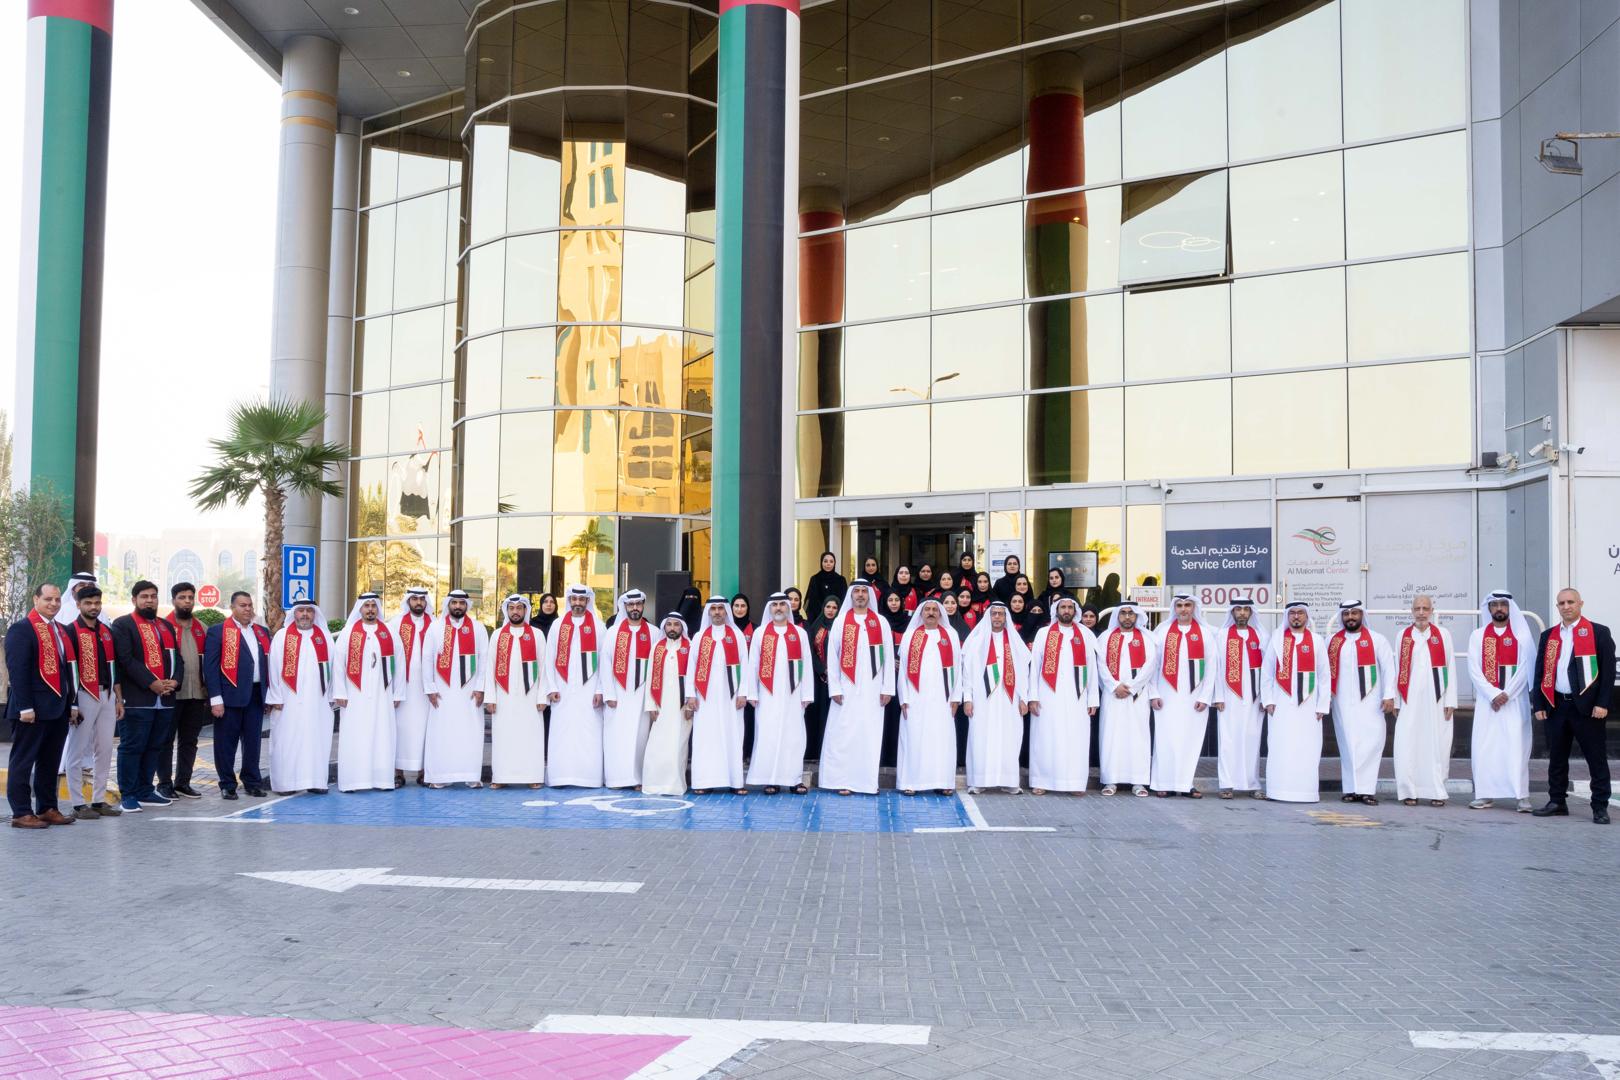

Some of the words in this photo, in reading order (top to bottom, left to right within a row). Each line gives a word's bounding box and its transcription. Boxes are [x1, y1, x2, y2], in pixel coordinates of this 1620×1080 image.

[1170, 545, 1207, 556] الخدمة
[1208, 544, 1241, 557] تقديم
[1243, 544, 1269, 555] مركز
[293, 552, 307, 573] P
[1181, 559, 1220, 570] Service
[1222, 558, 1257, 569] Center
[1287, 567, 1295, 575] Al
[201, 596, 217, 604] STOP
